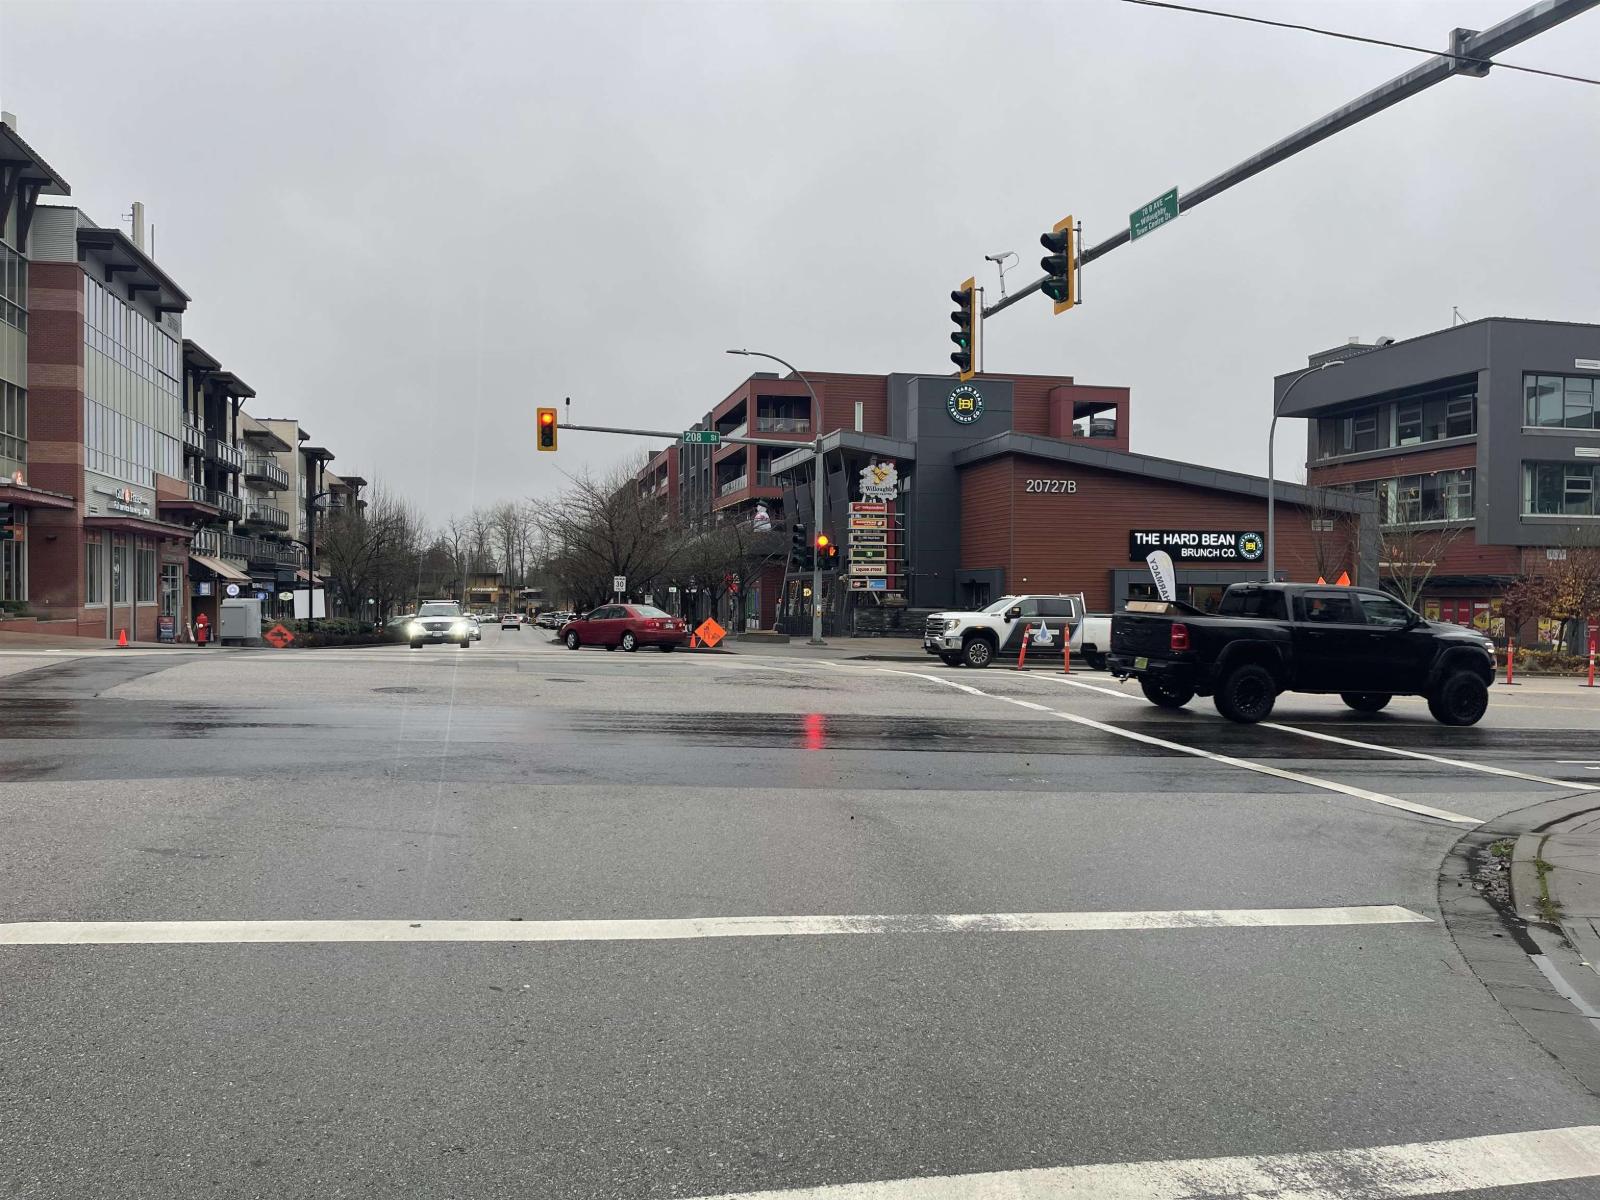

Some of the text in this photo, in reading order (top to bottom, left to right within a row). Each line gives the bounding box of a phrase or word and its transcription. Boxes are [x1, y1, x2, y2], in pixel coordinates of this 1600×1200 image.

[1153, 198, 1164, 210] AVE
[1140, 206, 1167, 226] Willoughby
[1148, 216, 1164, 230] Centre
[949, 392, 957, 405] THE
[973, 390, 982, 406] BEAN
[950, 408, 972, 422] BRUNCH
[685, 432, 718, 442] 208 St
[1026, 479, 1077, 493] 20727B
[1134, 532, 1236, 546] THE HARD BEAN
[1181, 548, 1238, 558] BRUNCH CO.
